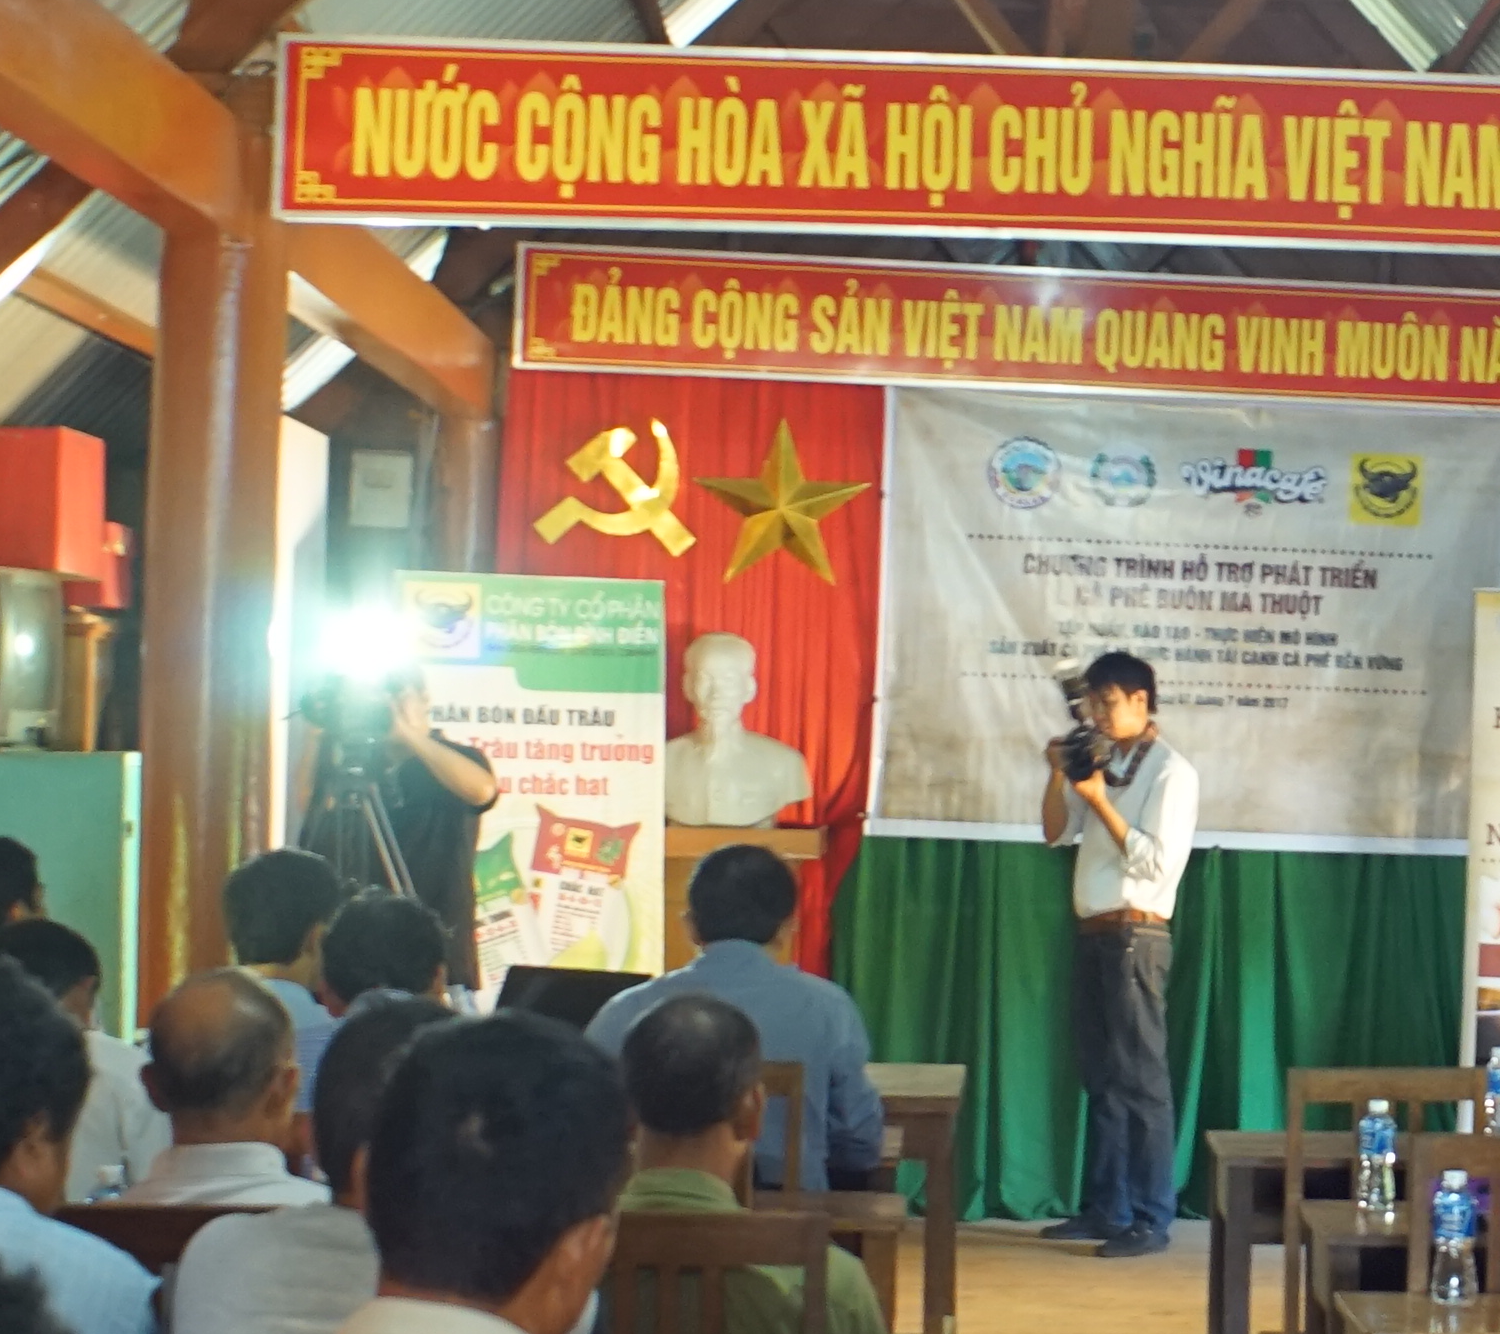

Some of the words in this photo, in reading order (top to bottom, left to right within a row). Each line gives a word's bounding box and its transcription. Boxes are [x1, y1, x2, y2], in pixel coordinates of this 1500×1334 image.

[353, 63, 500, 180] NƯỚC
[515, 74, 662, 199] CỘNG
[677, 75, 784, 187] HÒA
[798, 84, 870, 190] XÃ
[885, 84, 973, 208] HỘI
[990, 82, 1094, 197] CHỦ
[1108, 95, 1269, 200] NGHĨA
[1283, 98, 1392, 220] VIỆT
[570, 267, 681, 347] ĐẢNG
[692, 278, 800, 359] CỘNG
[809, 279, 892, 357] SẢN
[902, 289, 984, 370] VIỆT
[992, 304, 1084, 365] NAM
[1096, 309, 1226, 373] QUANG
[1237, 315, 1326, 377] VINH
[1336, 311, 1450, 382] MUÔN
[1260, 559, 1314, 586] PHÁT
[429, 704, 471, 723] HÂN
